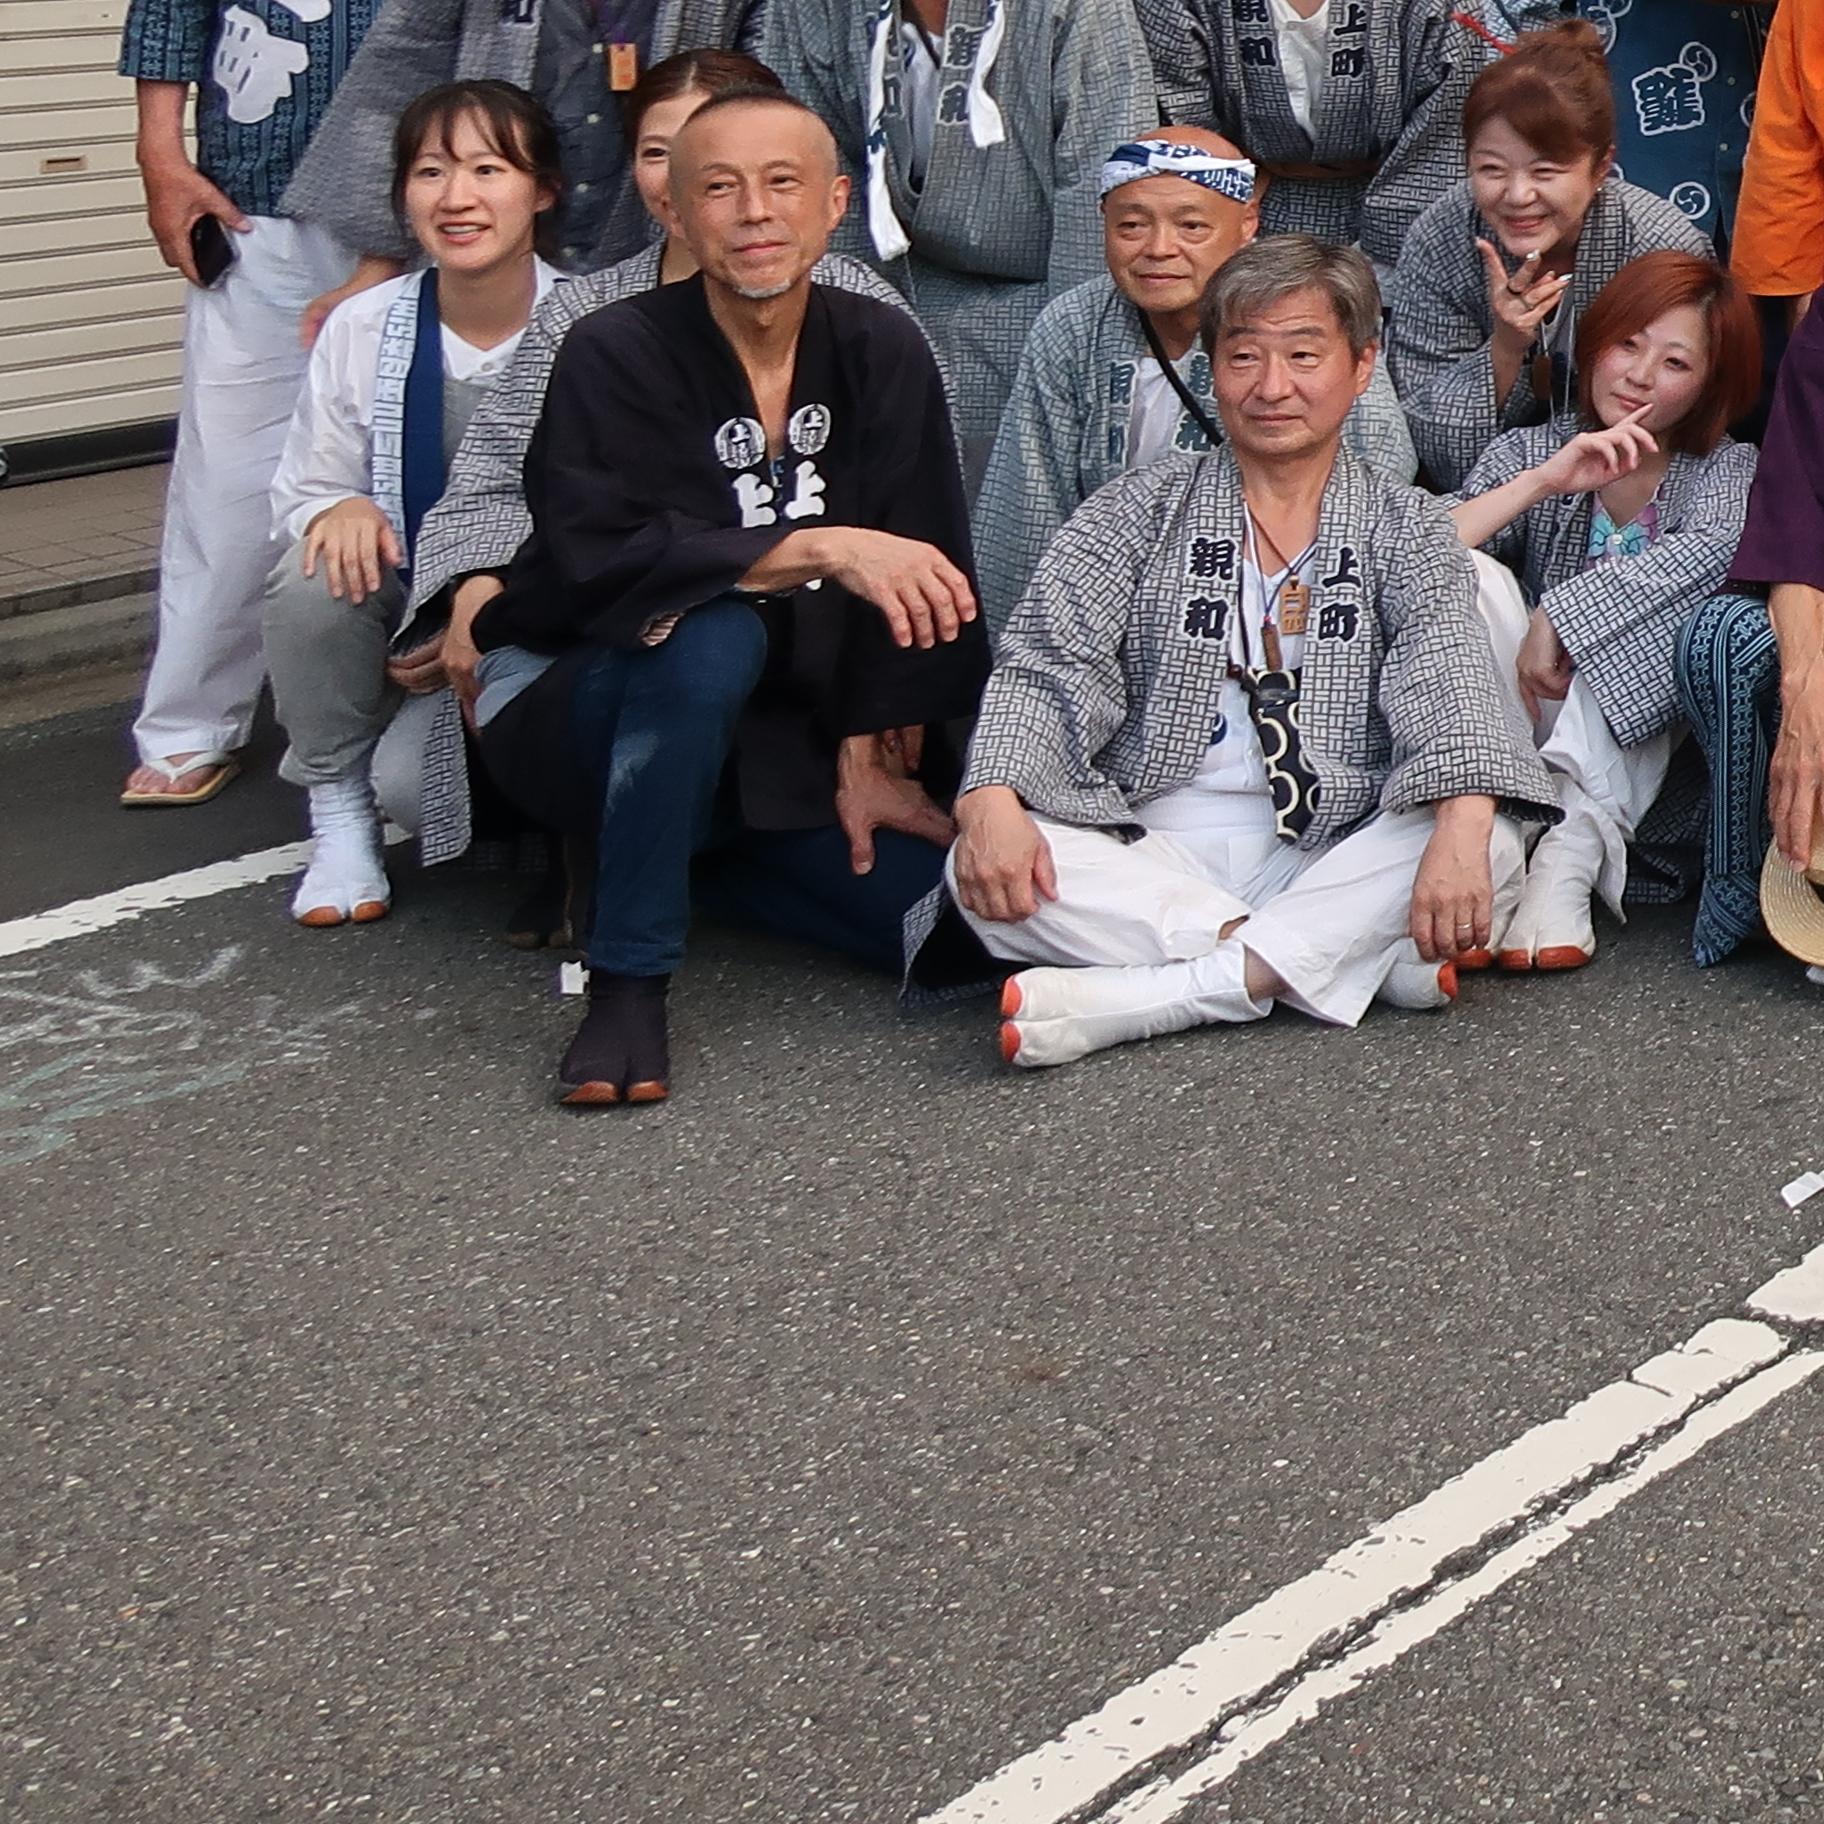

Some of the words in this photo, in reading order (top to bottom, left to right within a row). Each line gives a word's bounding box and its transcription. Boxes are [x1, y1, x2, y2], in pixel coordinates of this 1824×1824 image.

[1332, 3, 1367, 77] 上町
[1184, 536, 1238, 642] 親和
[1317, 547, 1362, 643] 上町
